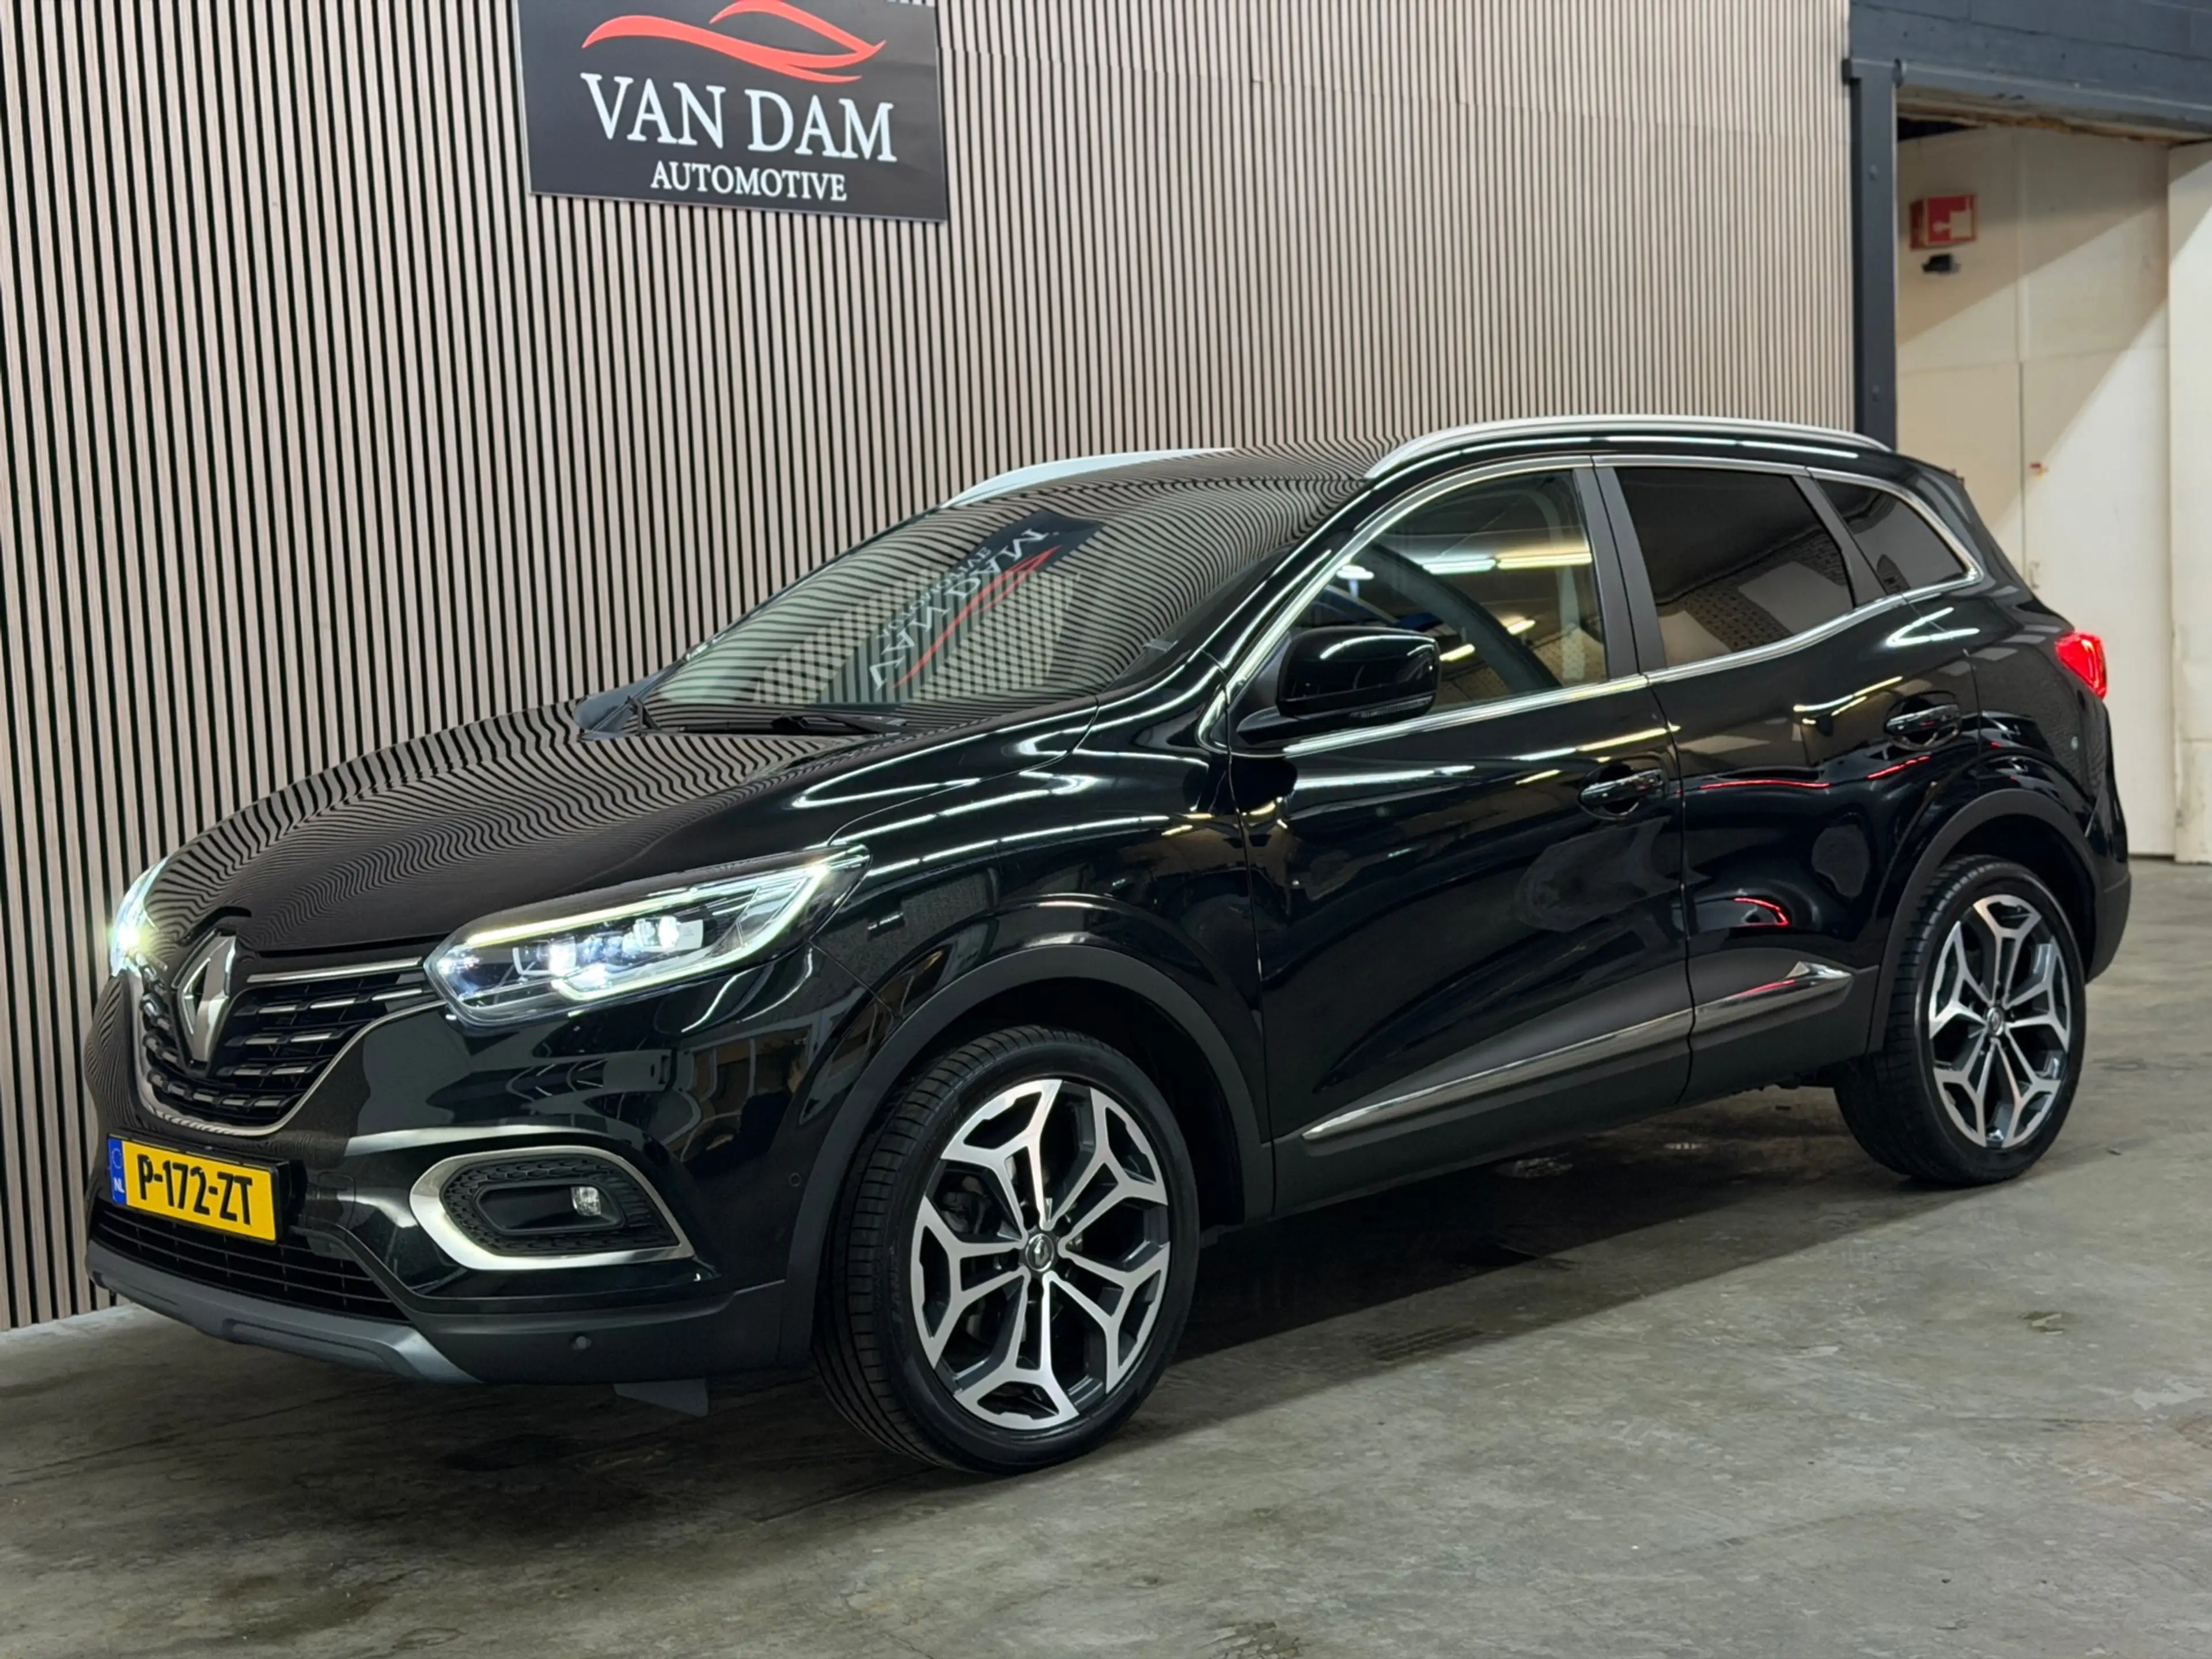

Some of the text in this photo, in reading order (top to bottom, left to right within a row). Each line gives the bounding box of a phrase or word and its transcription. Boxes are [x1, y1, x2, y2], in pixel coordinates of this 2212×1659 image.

[580, 73, 897, 162] VAN DAM
[650, 161, 847, 202] AUTOMOTIVE
[113, 1177, 125, 1194] NL
[137, 1154, 253, 1225] P-172-ZT
